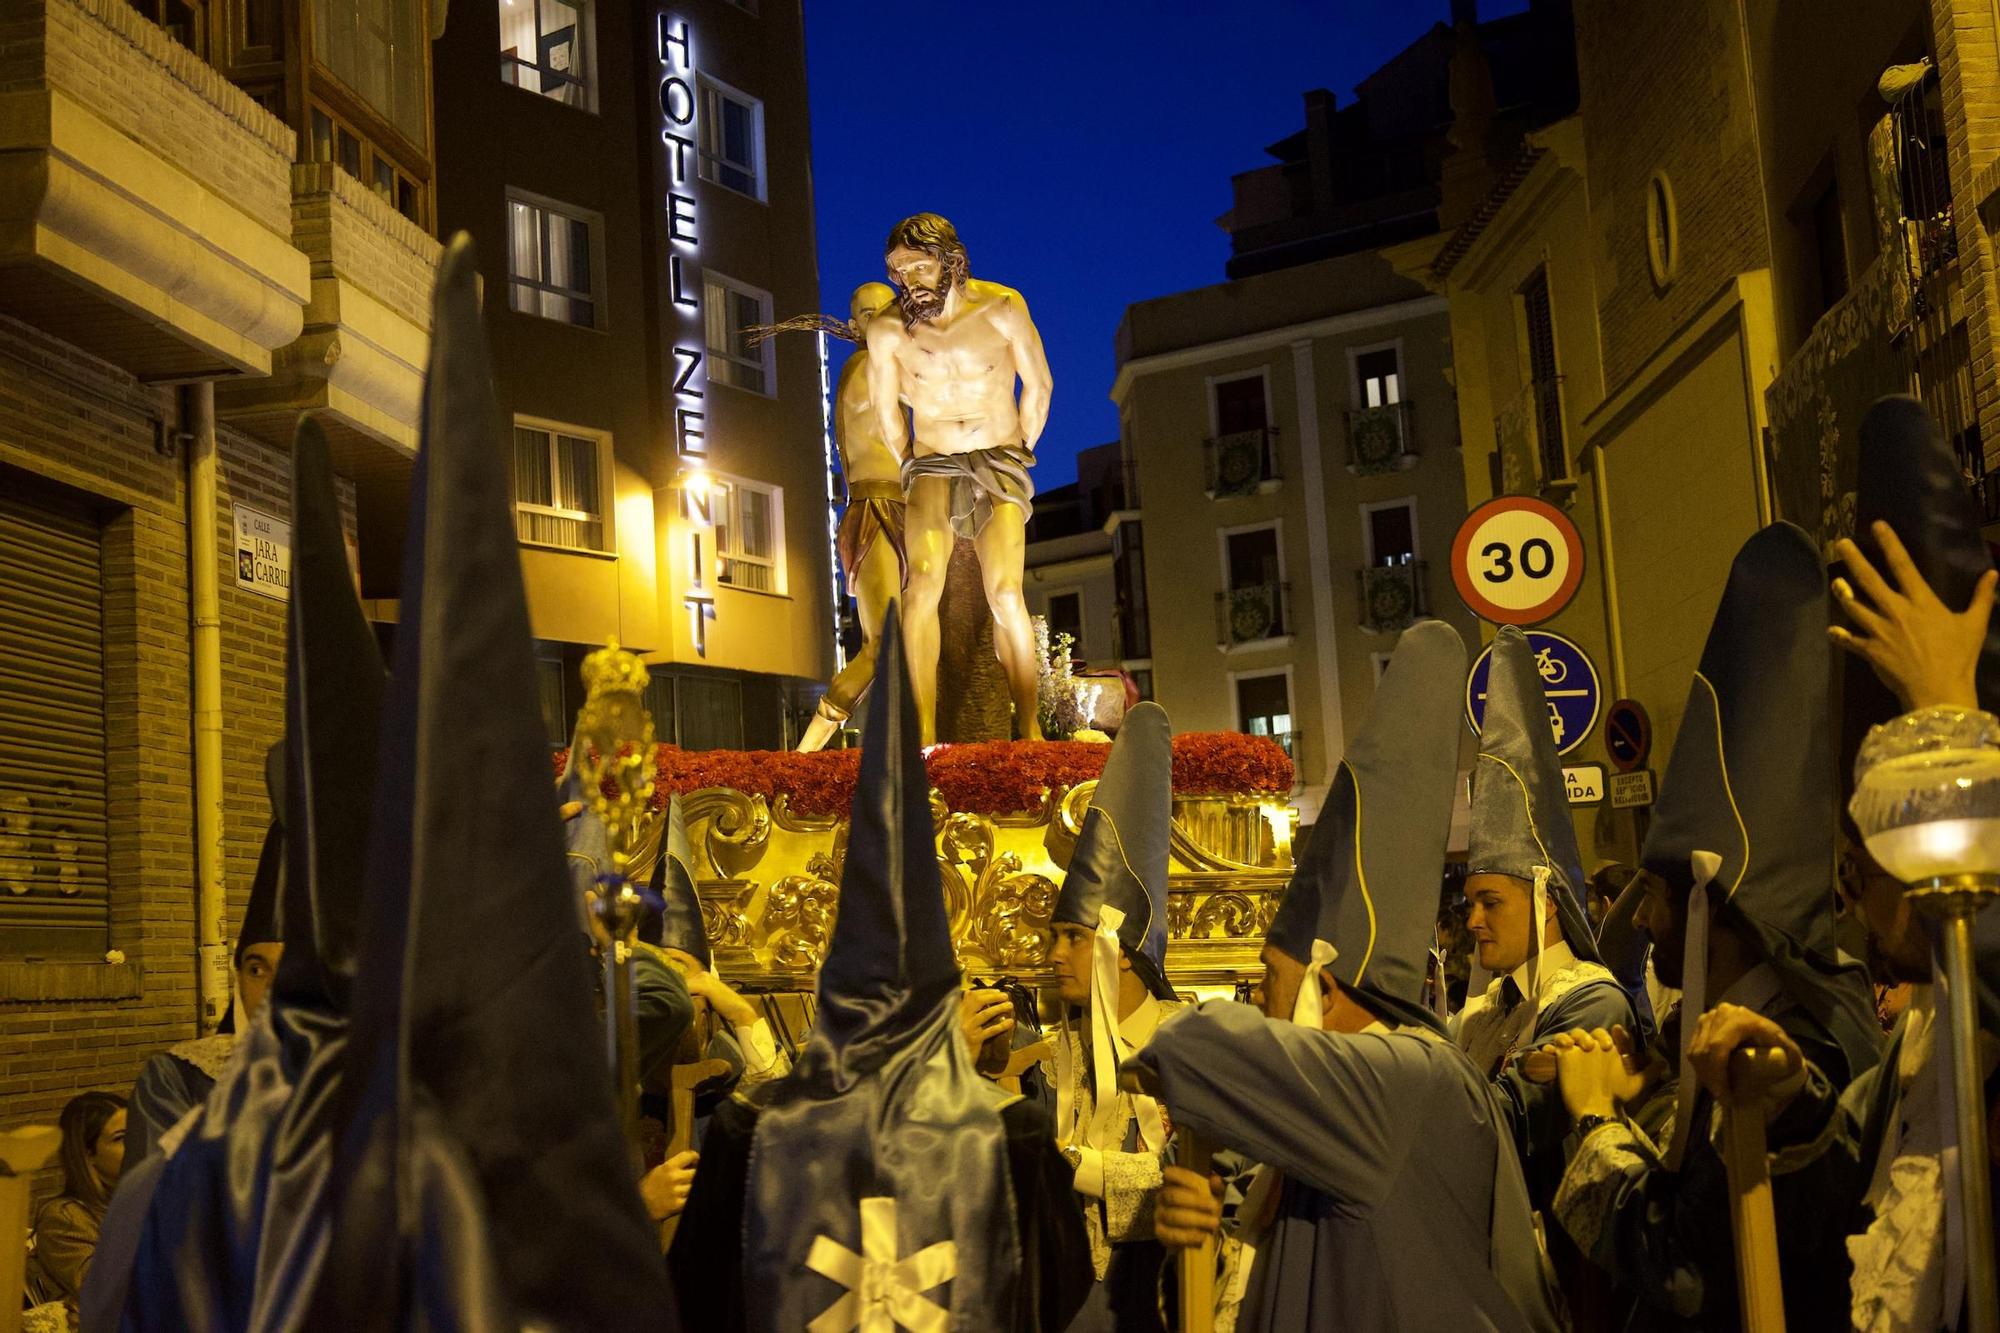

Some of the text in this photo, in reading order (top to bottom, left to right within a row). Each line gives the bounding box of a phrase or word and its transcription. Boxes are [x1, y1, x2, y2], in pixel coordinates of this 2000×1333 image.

[659, 14, 715, 659] HOTEL ZENIT
[254, 519, 271, 533] CALLE
[254, 538, 278, 562] JARA
[1481, 538, 1554, 583] 30
